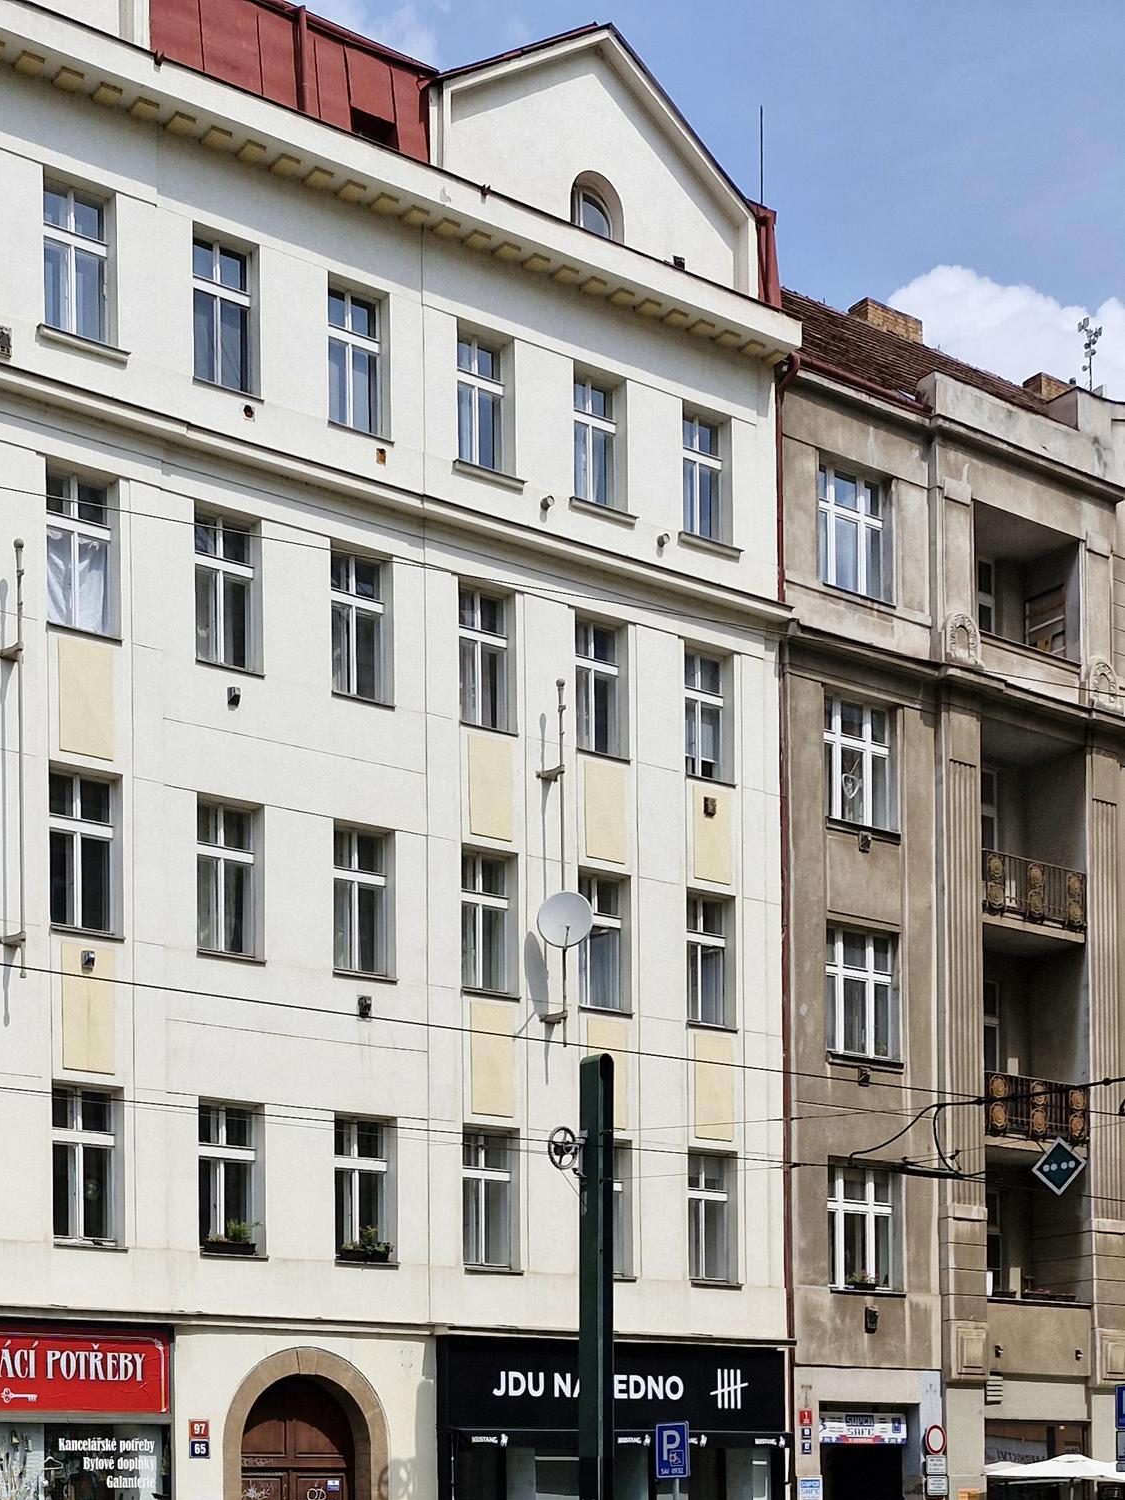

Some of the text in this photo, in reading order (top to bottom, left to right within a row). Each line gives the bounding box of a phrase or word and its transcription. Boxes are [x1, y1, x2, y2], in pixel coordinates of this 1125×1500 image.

[46, 1343, 145, 1382] POTŘEBY
[493, 1371, 684, 1400] JDU N EDNO
[193, 1423, 205, 1434] 97
[58, 1437, 155, 1453] Kancelářské potřeby
[194, 1443, 206, 1454] 65
[662, 1430, 681, 1461] P
[83, 1456, 115, 1472] Bytové
[106, 1475, 156, 1489] Galanterie
